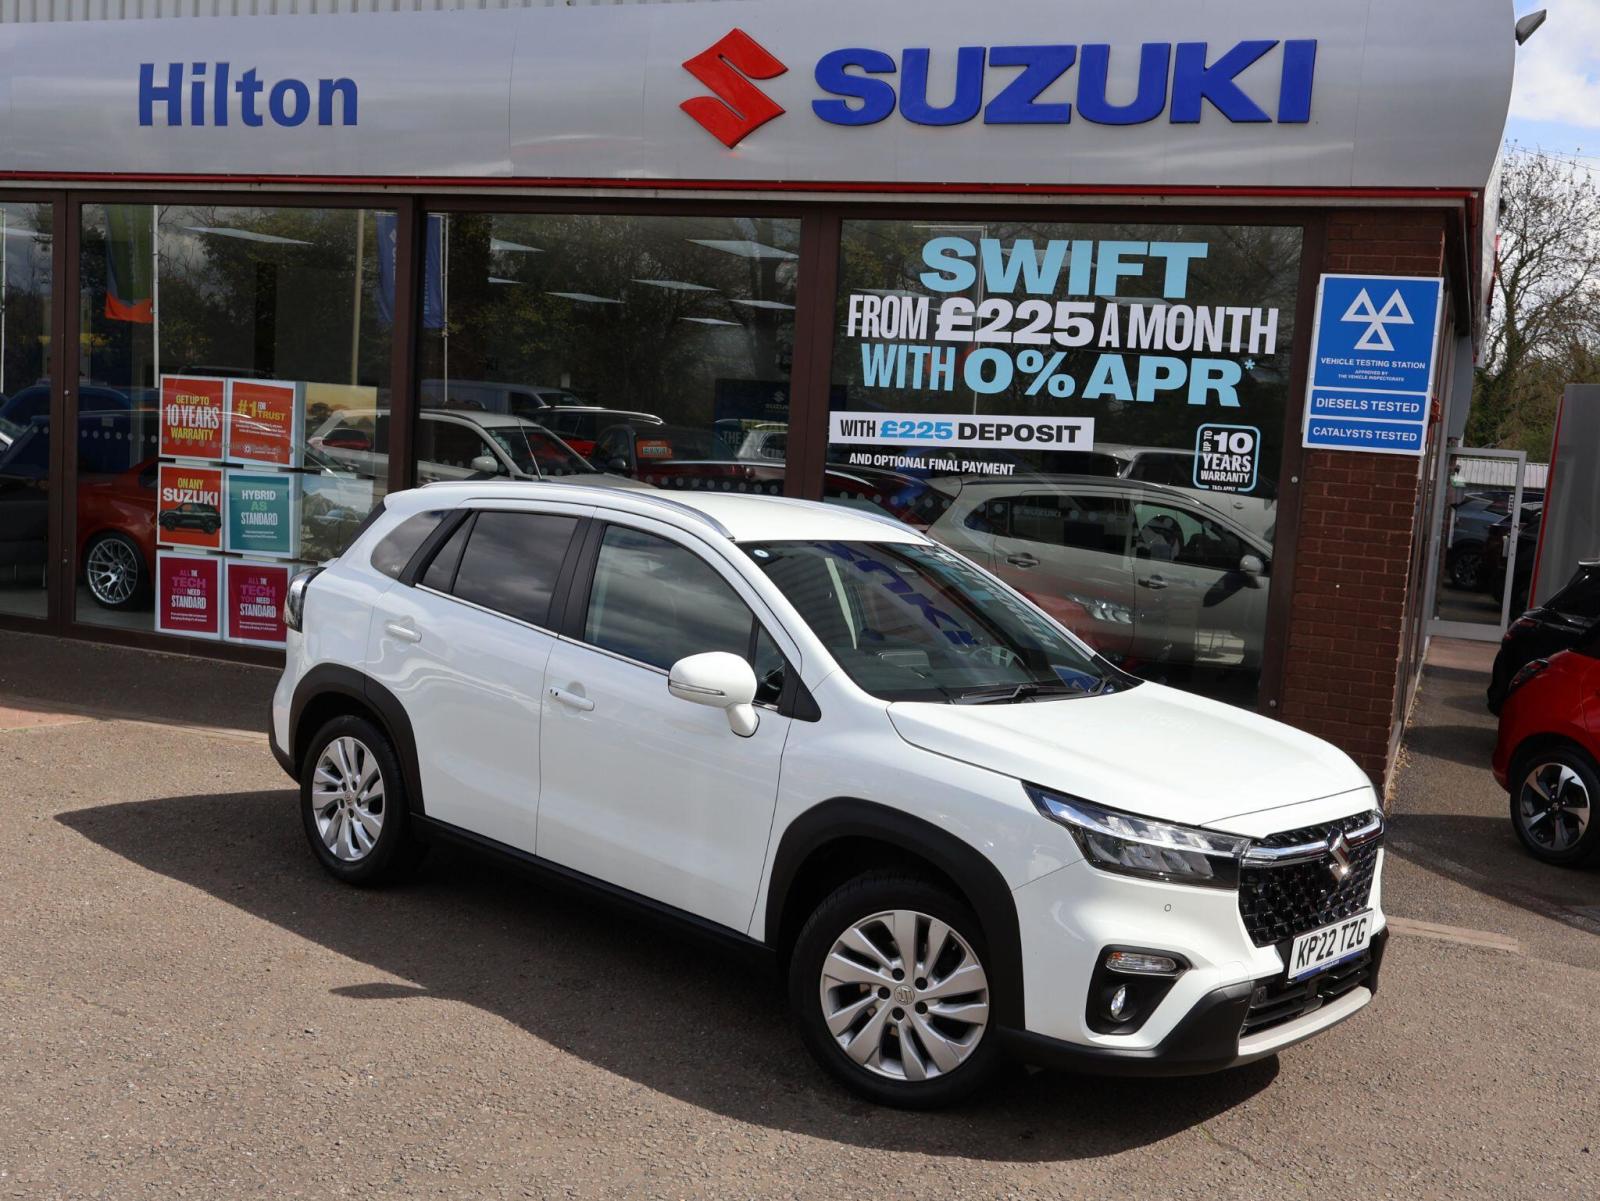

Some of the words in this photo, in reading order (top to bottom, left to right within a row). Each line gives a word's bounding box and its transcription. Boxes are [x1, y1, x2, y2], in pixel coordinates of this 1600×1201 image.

[811, 40, 1317, 126] SUZUKI
[139, 62, 358, 127] Hilton
[919, 236, 1208, 299] SWIFT
[847, 294, 930, 340] FROM
[935, 297, 1095, 347] £225
[1098, 303, 1120, 348] A
[1126, 304, 1279, 355] MONTH
[861, 343, 955, 391] WITH
[963, 348, 1075, 399] 0%
[1320, 358, 1354, 366] VEHICLE
[1356, 359, 1389, 368] TESTING
[1392, 360, 1426, 369] STATION
[176, 395, 190, 404] GET
[1316, 398, 1368, 410] DIESELS
[1371, 401, 1420, 413] TESTED
[238, 400, 256, 417] #1
[257, 410, 286, 421] TRUST
[166, 404, 178, 426] 10
[181, 405, 219, 429] YEARS
[171, 427, 214, 440] WARRANTY
[840, 419, 876, 438] WITH
[880, 420, 953, 439] £225
[958, 423, 1081, 443] DEPOSIT
[1203, 430, 1213, 440] TO
[1313, 427, 1373, 439] CATALYSTS
[1375, 430, 1417, 441] TESTED
[1203, 441, 1212, 452] UP
[1214, 431, 1253, 454] 10
[849, 453, 872, 465] AND
[874, 454, 927, 469] OPTIONAL
[929, 458, 960, 472] FINAL
[962, 461, 1015, 476] PAYMENT
[1203, 453, 1252, 472] YEARS
[178, 477, 189, 488] ON
[189, 478, 204, 489] ANY
[1200, 470, 1250, 483] WARRANTY
[163, 487, 219, 506] SUZUKI
[242, 489, 276, 500] HYBRID
[250, 501, 268, 512] AS
[241, 512, 278, 526] STANDARD
[171, 577, 206, 588] TECH
[187, 588, 200, 596] NEED
[240, 584, 276, 597] TECH
[171, 595, 206, 610] STANDARD
[240, 603, 276, 618] STANDARD
[1296, 928, 1337, 969] KP22
[1340, 917, 1367, 952] TZG
